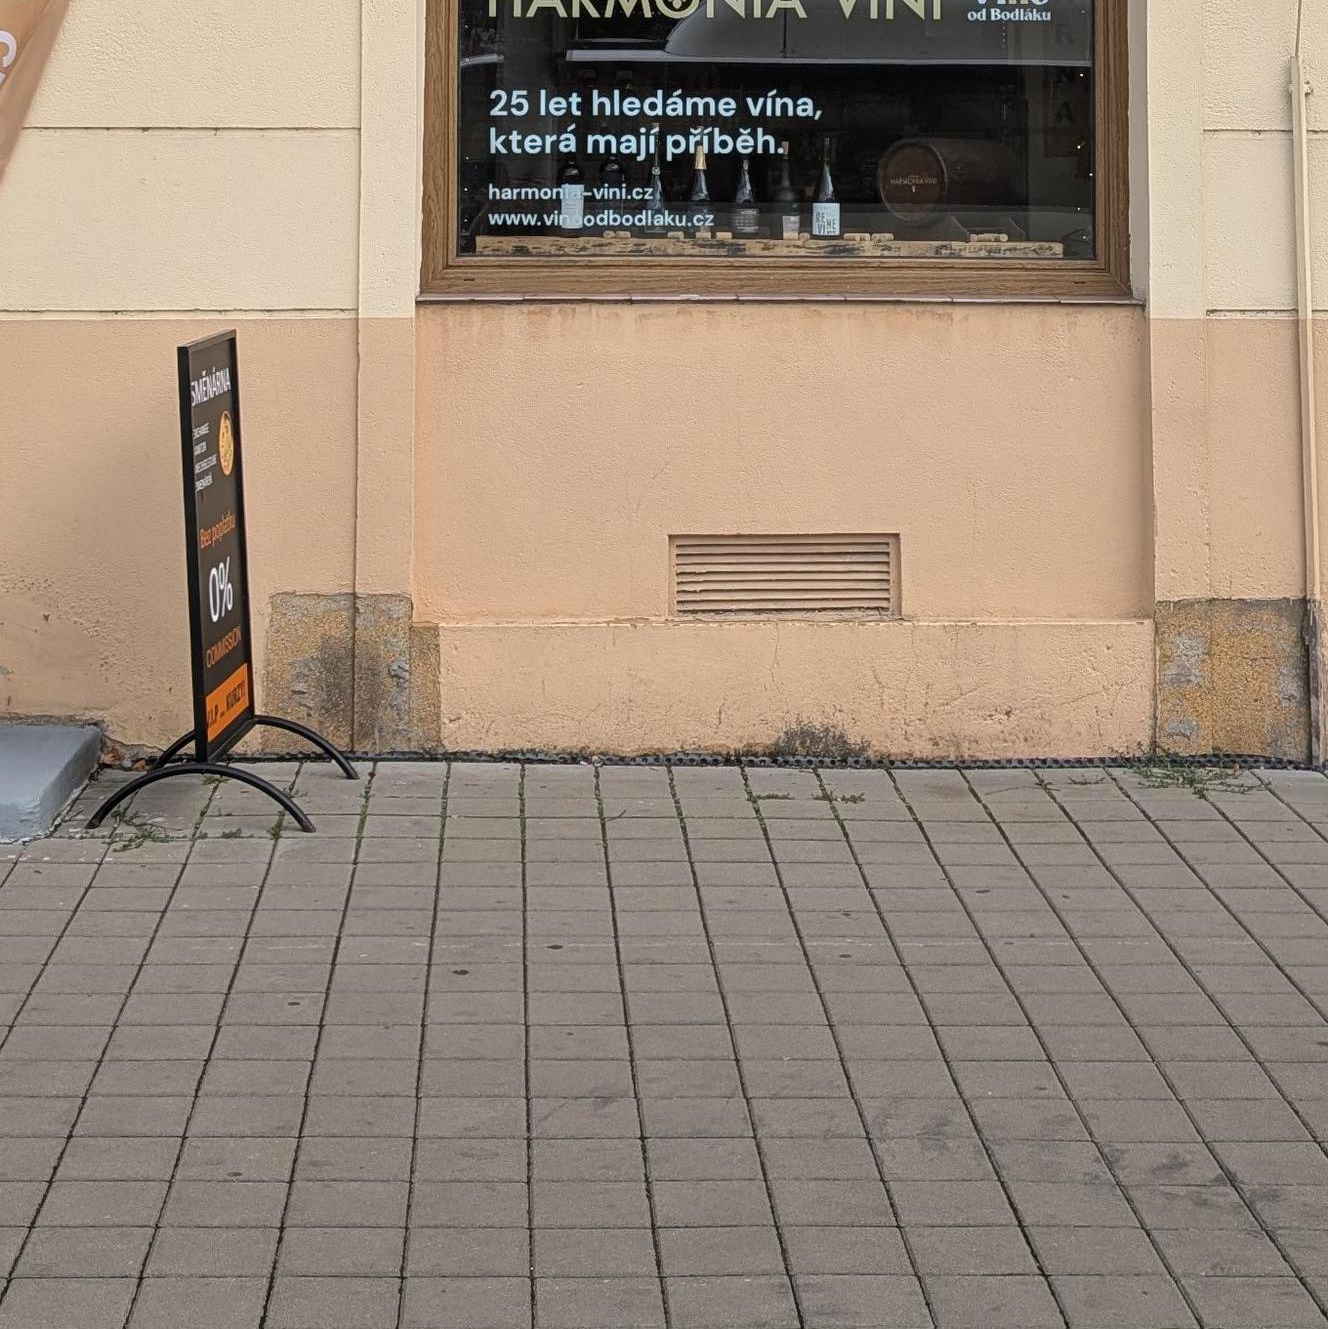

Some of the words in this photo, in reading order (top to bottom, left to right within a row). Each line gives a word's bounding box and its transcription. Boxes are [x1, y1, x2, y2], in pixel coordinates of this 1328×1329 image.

[968, 7, 986, 22] od
[989, 6, 1052, 22] Bodláku
[489, 90, 530, 117] 25
[539, 89, 582, 117] let
[592, 89, 737, 118] hledáme
[746, 90, 822, 121] vína,
[489, 123, 576, 154] která
[586, 127, 659, 161] mají
[666, 127, 784, 162] příběh.
[488, 183, 654, 202] harmonia-vini.cz
[209, 556, 234, 623] 0%
